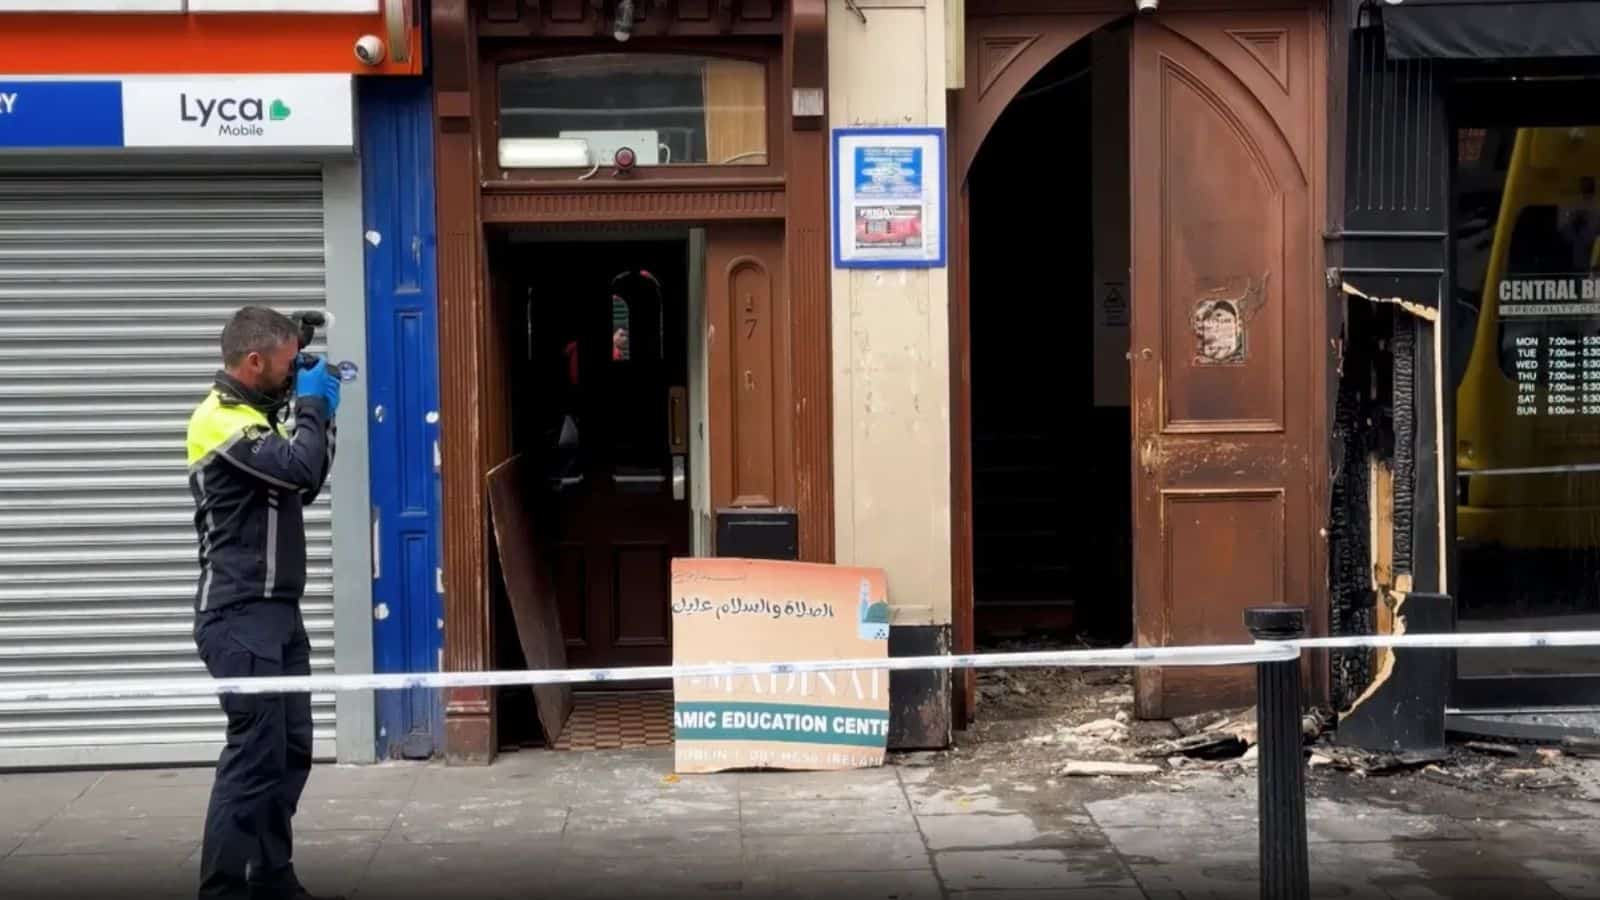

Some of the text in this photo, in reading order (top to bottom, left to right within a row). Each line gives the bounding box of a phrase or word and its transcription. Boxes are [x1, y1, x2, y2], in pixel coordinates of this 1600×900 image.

[0, 92, 17, 113] Y
[180, 93, 264, 127] Lyca
[218, 124, 264, 137] Mobile
[1498, 280, 1578, 301] CENTRAL
[1516, 337, 1538, 346] MON
[1517, 348, 1537, 357] TUE
[1515, 360, 1538, 369] WED
[1517, 372, 1537, 381] THU
[1519, 383, 1536, 392] FRI
[1517, 394, 1536, 403] SAT
[1516, 406, 1537, 415] SUN
[721, 711, 828, 733] EDUCATION
